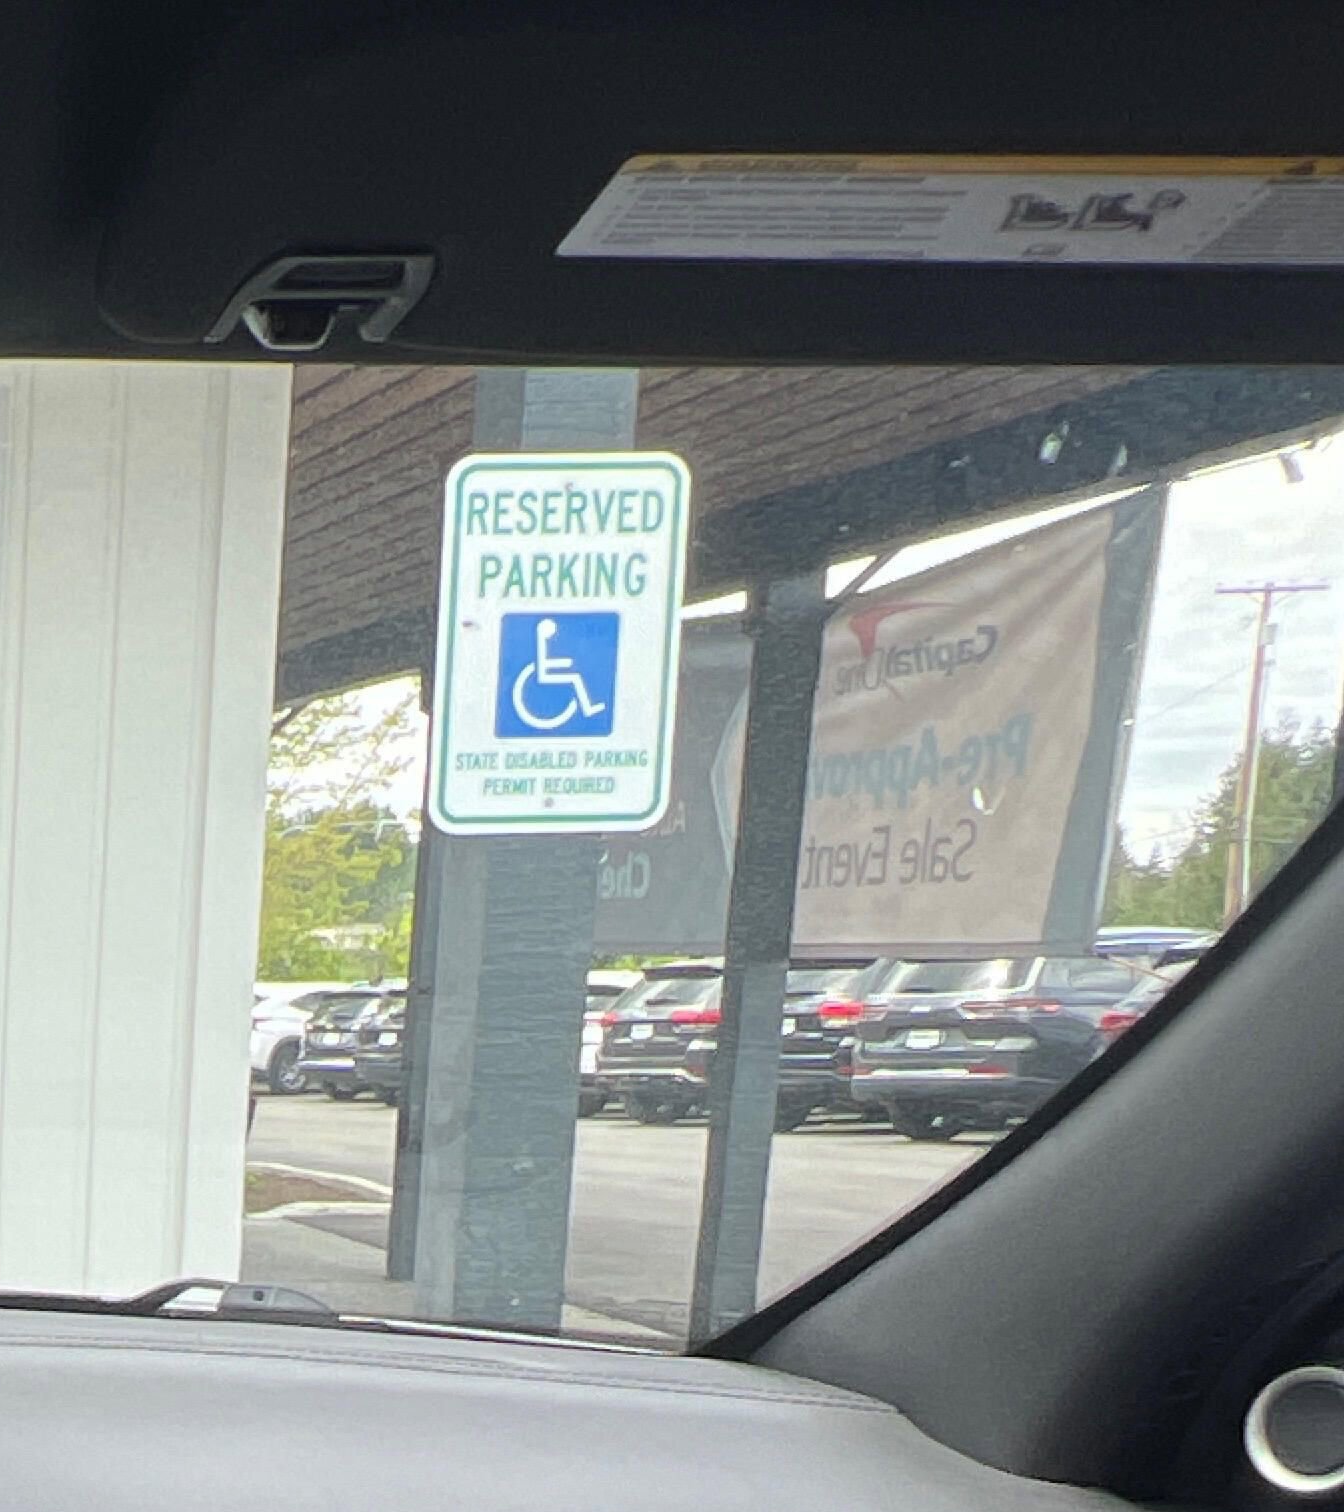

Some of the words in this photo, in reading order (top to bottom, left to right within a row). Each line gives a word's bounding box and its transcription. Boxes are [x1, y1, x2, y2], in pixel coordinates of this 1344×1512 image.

[466, 488, 664, 536] RESERVED
[478, 552, 648, 598] PARKING
[455, 753, 499, 771] STATE
[504, 751, 577, 769] DISABLED
[584, 749, 649, 768] PARKING
[482, 778, 537, 796] PERMIT
[543, 776, 615, 794] REQUIRED
